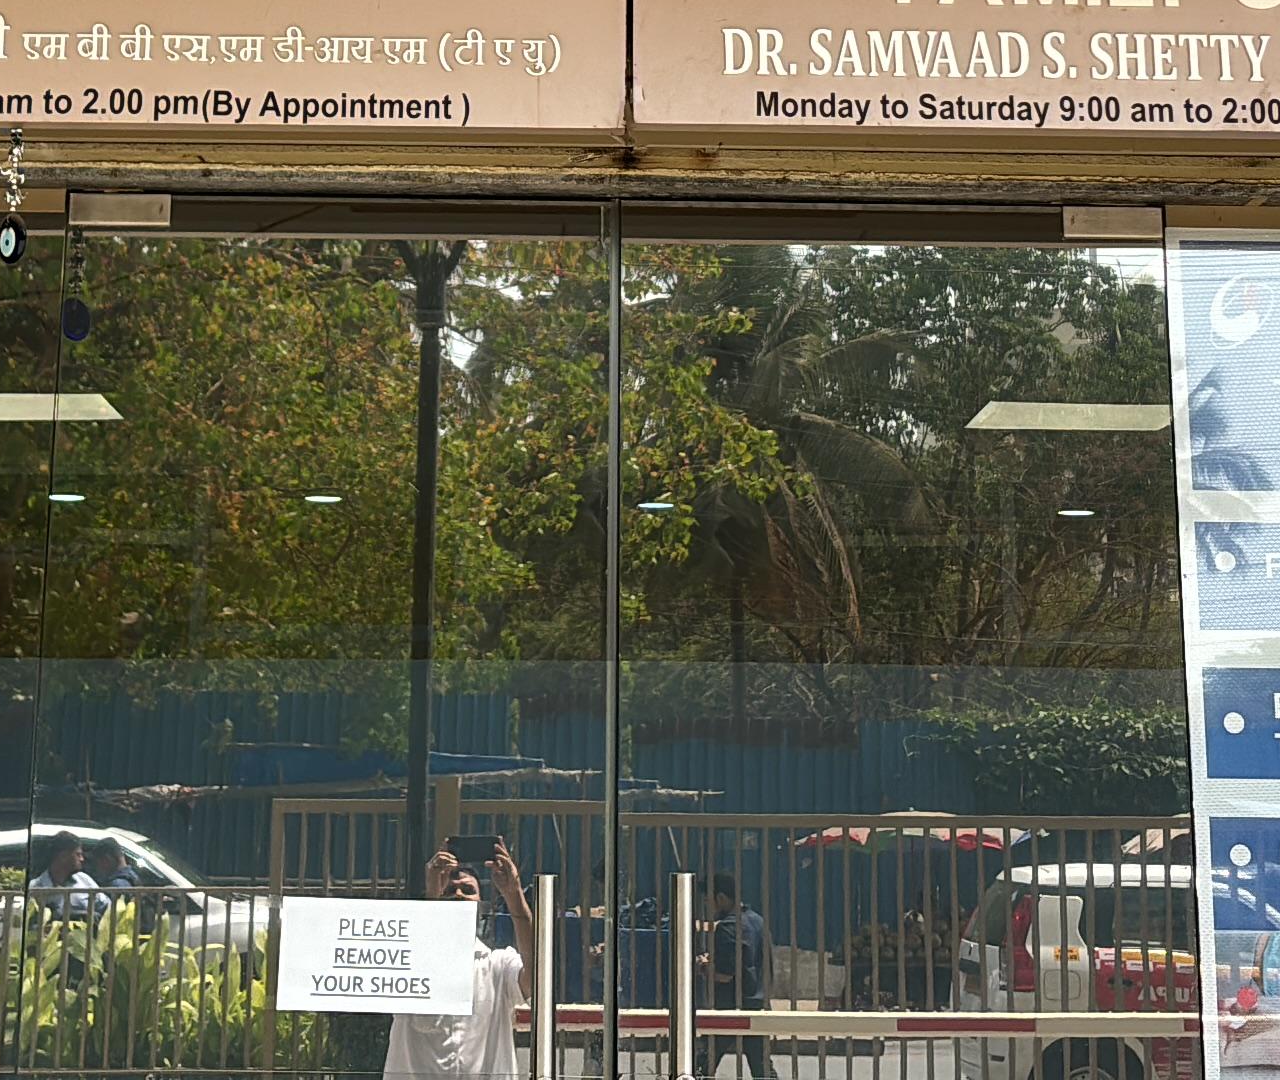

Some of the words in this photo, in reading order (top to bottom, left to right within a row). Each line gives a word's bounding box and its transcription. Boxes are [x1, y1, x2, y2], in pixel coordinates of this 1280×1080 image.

[22, 33, 69, 61] एम
[76, 23, 111, 61] बी
[119, 23, 154, 62] बी
[721, 27, 798, 77] DR.
[808, 28, 1031, 79] SAMVAAD
[1042, 30, 1078, 80] S.
[1089, 32, 1272, 83] SHETTY
[43, 88, 73, 115] to
[82, 88, 143, 116] 2.00
[259, 92, 453, 125] Appointment
[755, 91, 871, 125] Monday
[880, 92, 910, 120] to
[918, 93, 1050, 127] Saturday
[1059, 95, 1121, 122] 9:00
[1130, 100, 1174, 123] am
[1183, 96, 1214, 123] to
[338, 918, 410, 938] PLEASE
[334, 947, 412, 966] REMOVE
[311, 974, 364, 993] YOUR
[370, 976, 431, 995] SHOES
